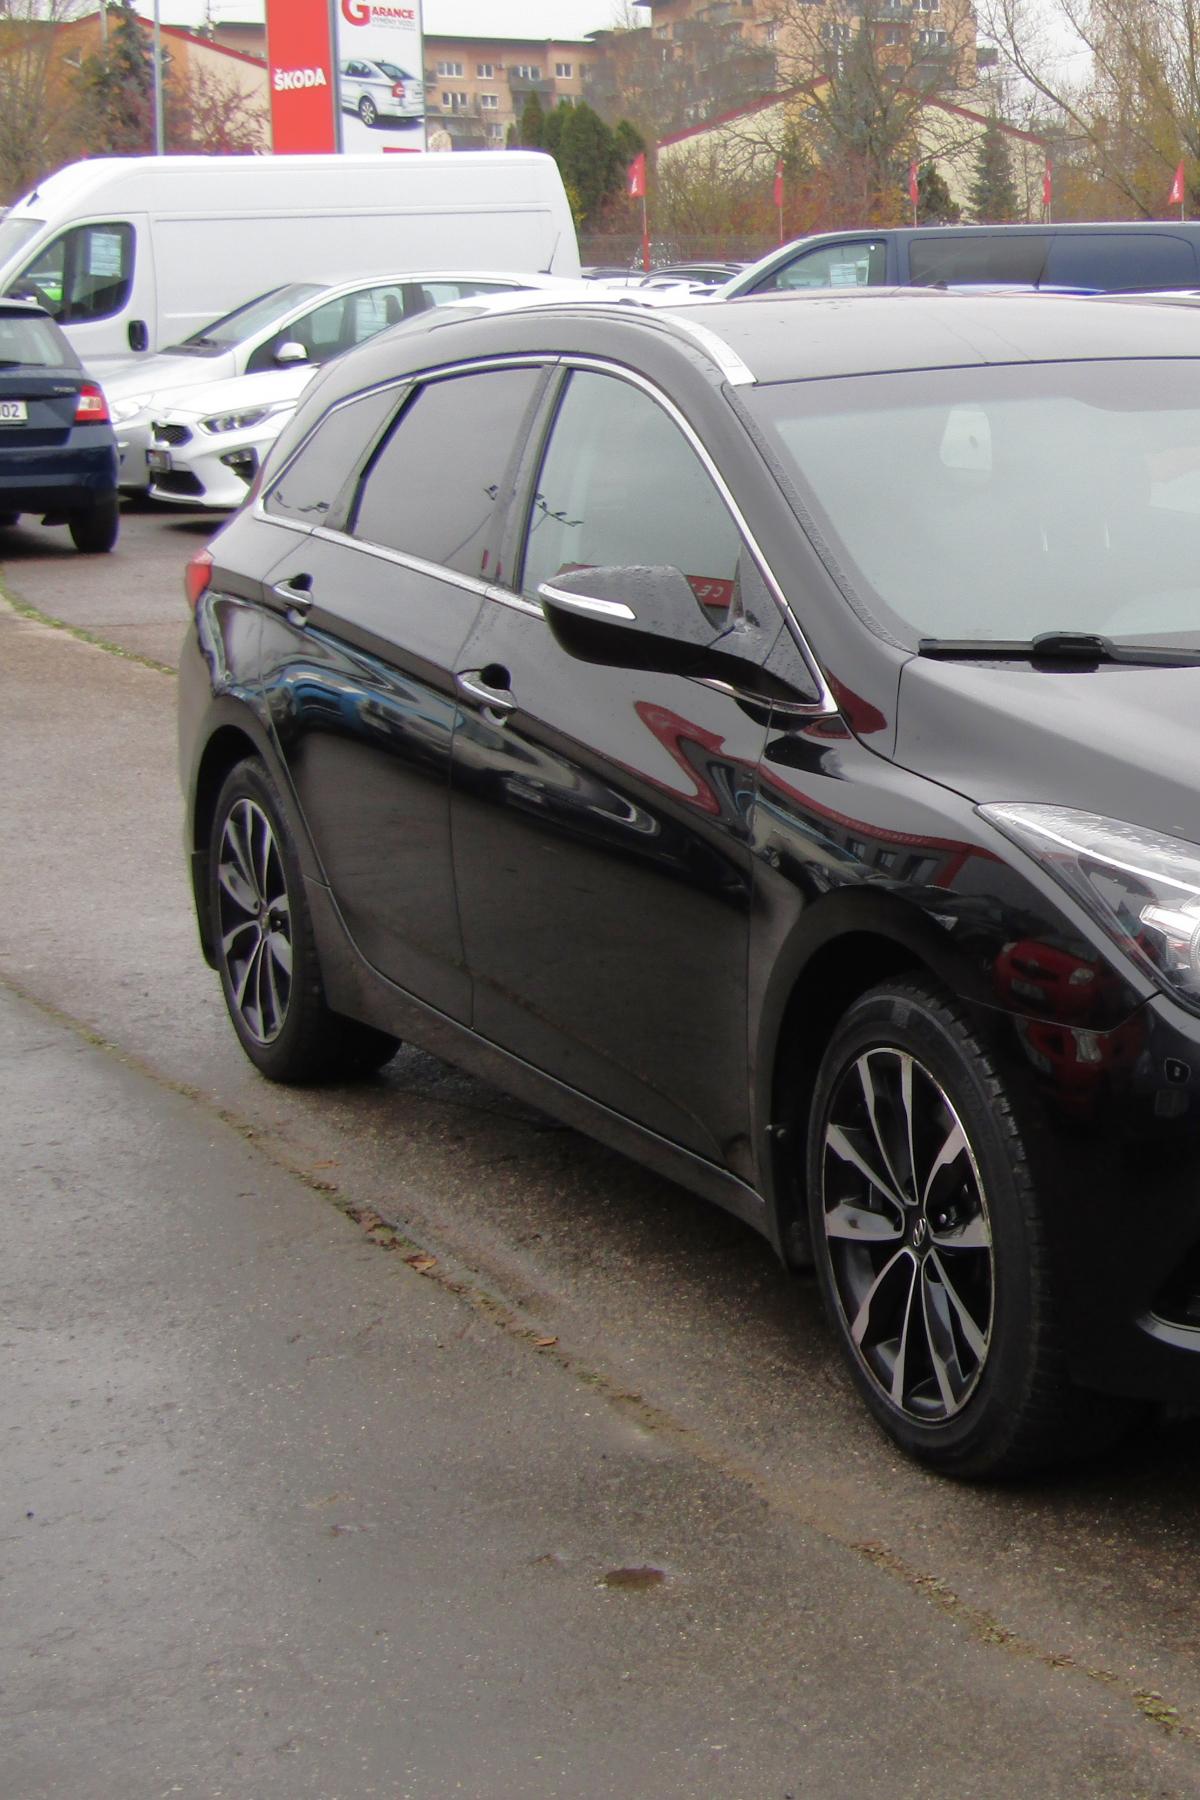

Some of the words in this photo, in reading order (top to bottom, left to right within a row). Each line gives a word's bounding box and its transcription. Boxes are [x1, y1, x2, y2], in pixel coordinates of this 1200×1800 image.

[341, 0, 415, 27] GARANCE
[274, 68, 327, 91] ŠKODA
[0, 404, 20, 418] 02
